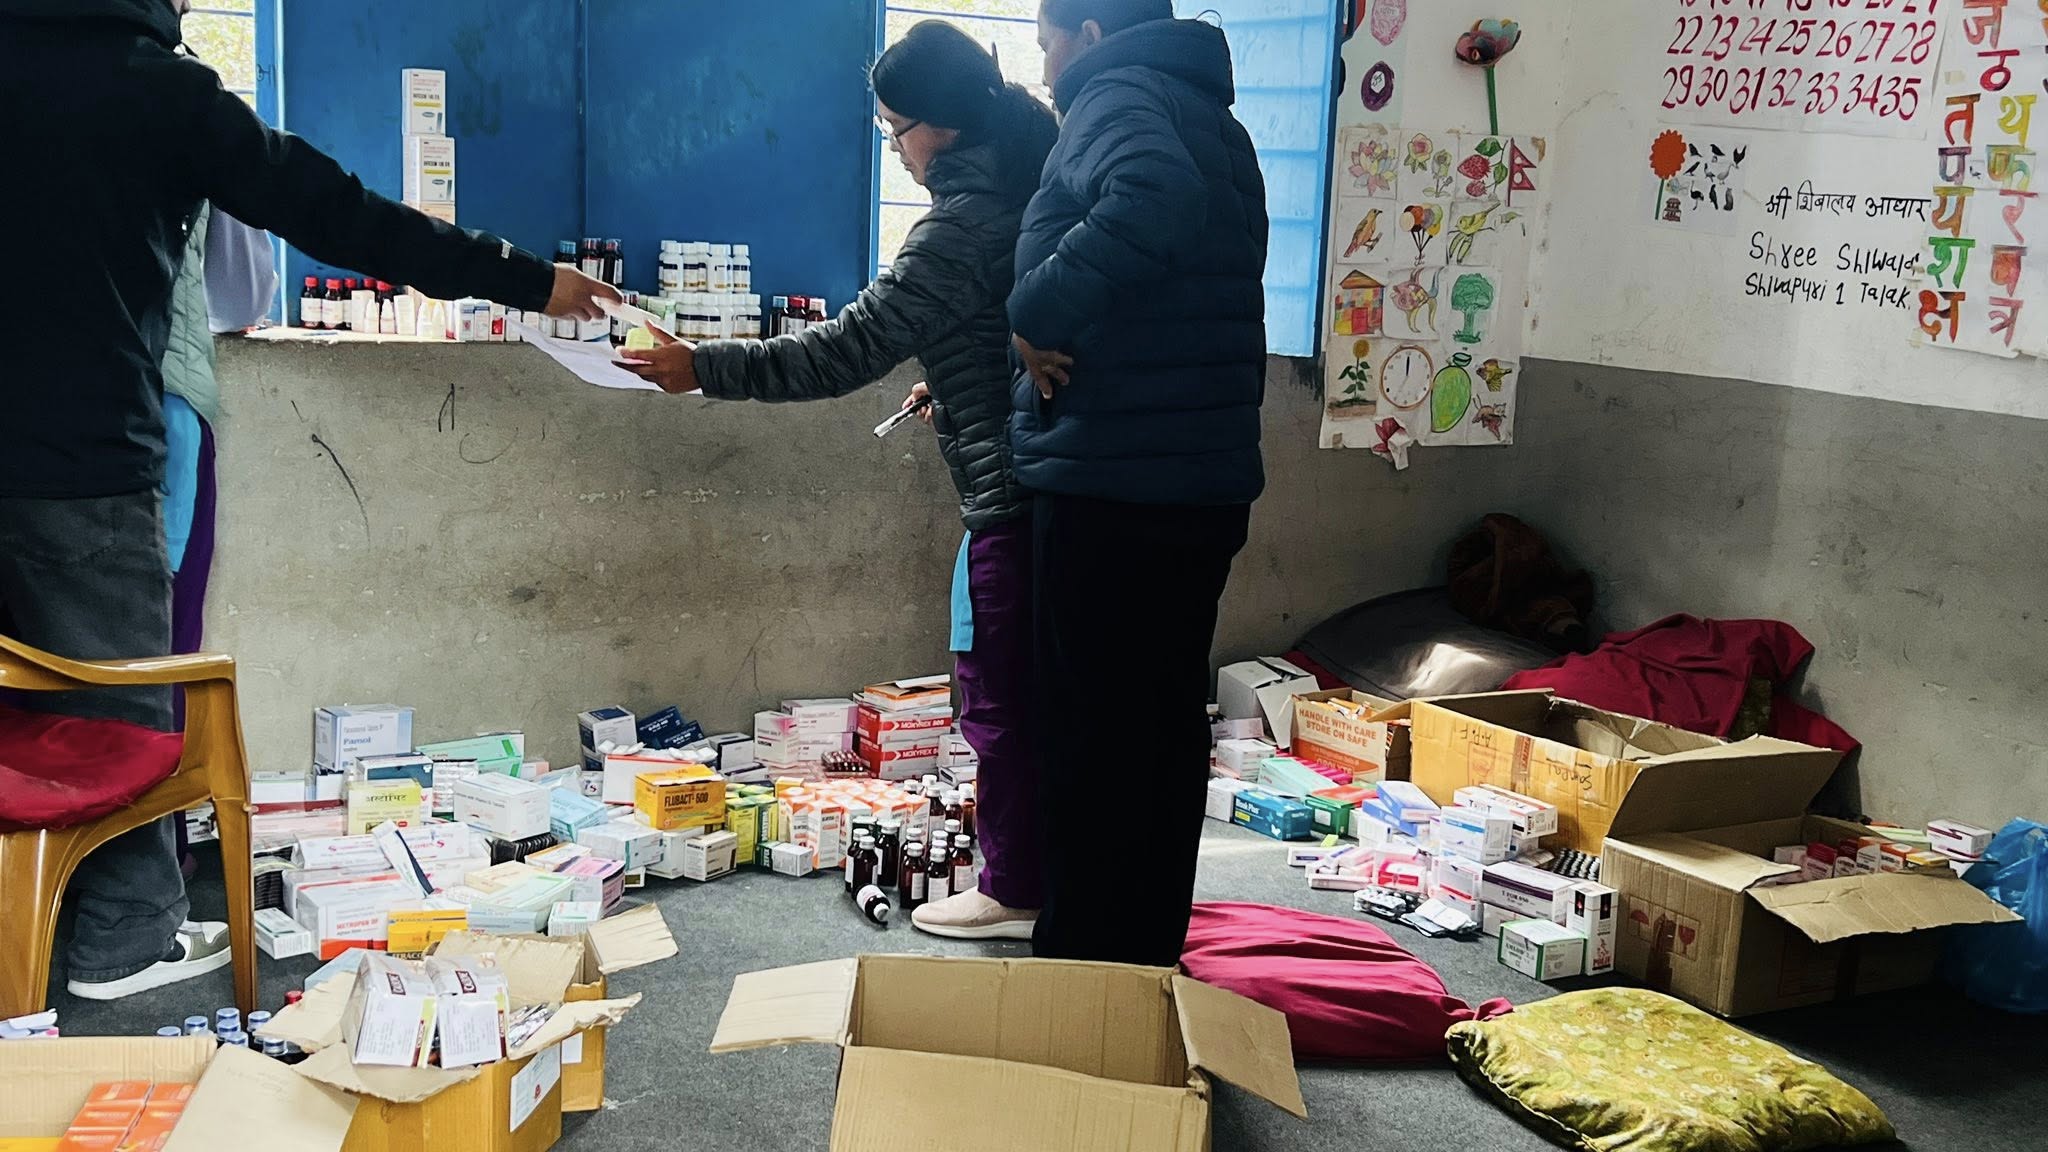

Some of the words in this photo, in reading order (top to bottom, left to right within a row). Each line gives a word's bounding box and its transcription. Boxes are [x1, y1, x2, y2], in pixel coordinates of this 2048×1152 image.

[1666, 15, 1702, 55] 22
[1701, 14, 1739, 61] 23
[1738, 16, 1777, 56] 24
[1775, 19, 1817, 55] 25
[1815, 19, 1858, 58] 26
[1854, 20, 1896, 64] 27
[1891, 20, 1936, 65] 28
[1977, 50, 2020, 91] ठ
[1661, 65, 1694, 109] 29
[1695, 66, 1728, 107] 30
[1729, 66, 1767, 115] 31
[1768, 68, 1802, 108] 32
[1804, 71, 1840, 115] 33
[1843, 73, 1883, 115] 34
[1879, 76, 1922, 121] 35
[1944, 93, 1981, 145] त
[1997, 94, 2038, 148] थ
[1938, 146, 1972, 185] प
[1932, 186, 1975, 237] य
[1999, 189, 2039, 244] र
[1749, 231, 1817, 269] Shree
[1927, 237, 1975, 289] श
[1836, 282, 1844, 304] 1
[1299, 707, 1329, 724] HANDLE
[1331, 718, 1352, 731] WITH
[1354, 726, 1376, 740] CARE
[1306, 720, 1331, 735] STORE
[1347, 734, 1368, 747] SAFE
